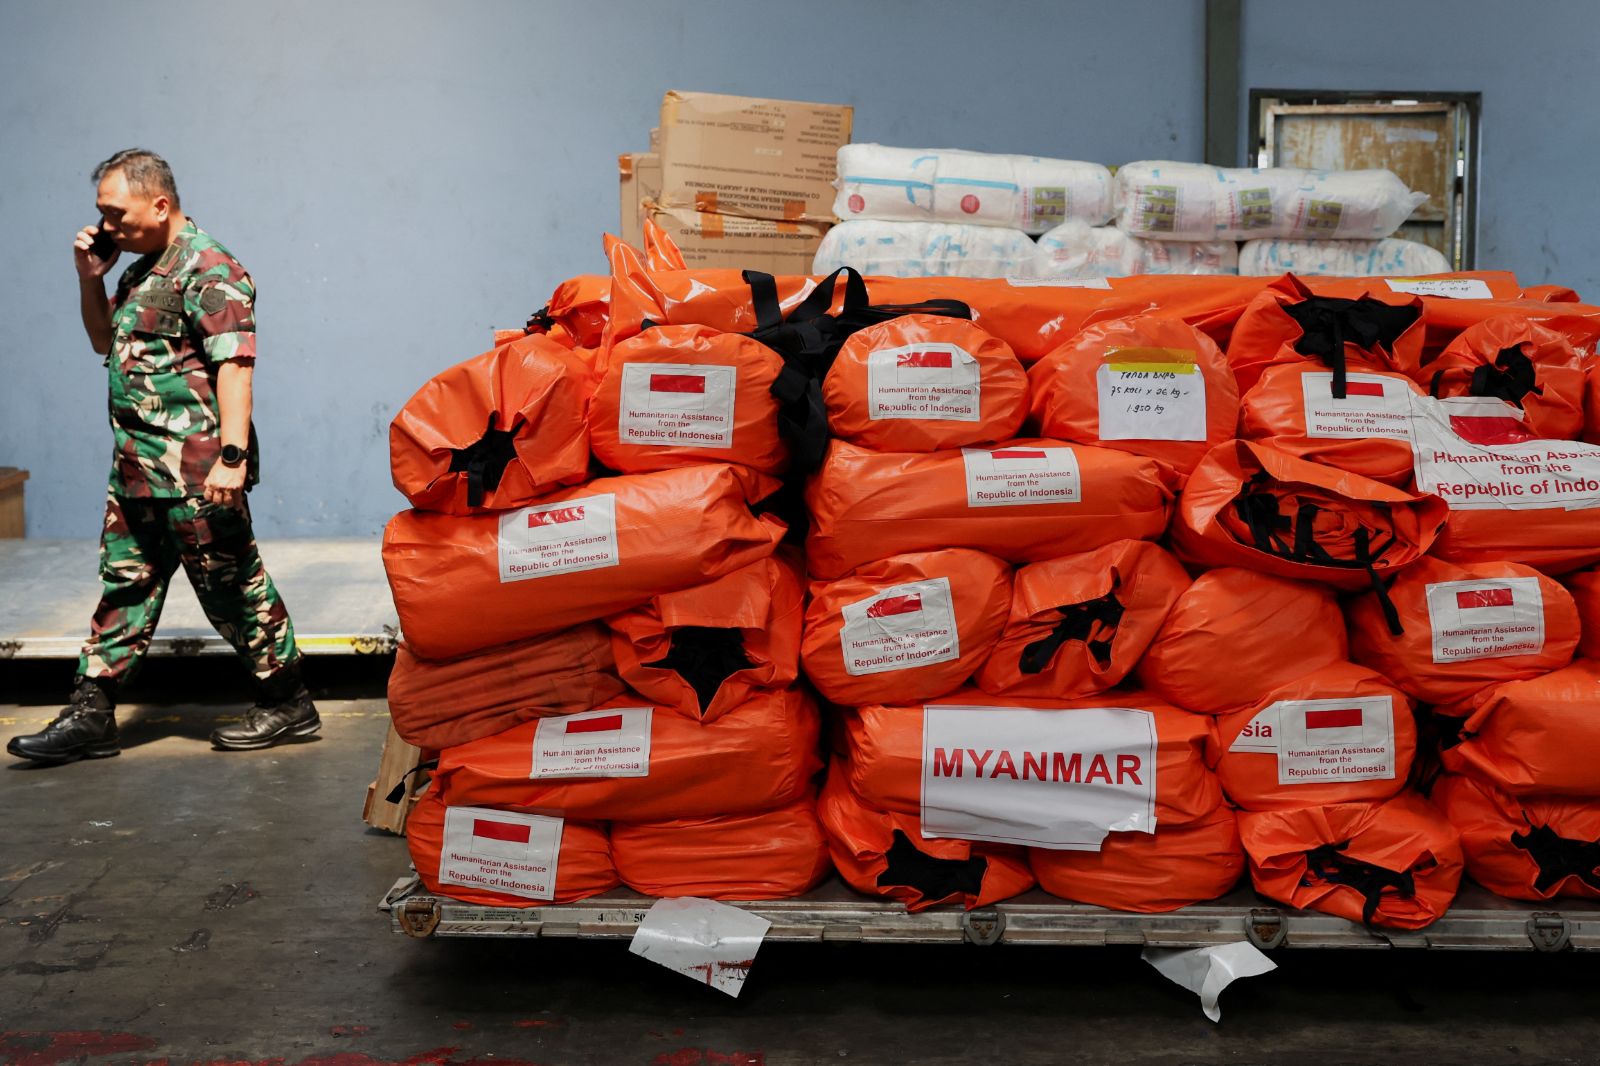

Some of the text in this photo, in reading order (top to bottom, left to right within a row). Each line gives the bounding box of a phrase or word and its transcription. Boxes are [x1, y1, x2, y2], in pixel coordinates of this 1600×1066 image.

[931, 387, 972, 395] Assistance
[878, 404, 916, 412] Republic
[931, 404, 971, 414] Indonesia
[629, 410, 724, 422] Humanitarian Assistance
[1366, 412, 1406, 420] Assistance
[628, 428, 666, 438] Republic
[679, 430, 723, 440] Indonesia
[1501, 464, 1572, 475] from the
[976, 473, 1027, 481] Humanitarian
[977, 491, 1016, 500] Republic
[1030, 488, 1072, 496] Indonesia
[1436, 482, 1524, 498] Republic
[1530, 480, 1548, 494] of
[564, 535, 607, 547] Assistance
[509, 562, 550, 573] Republic
[564, 552, 608, 564] Indonesia
[1442, 625, 1535, 636] Humanitarian Assistance
[1442, 646, 1481, 656] Republic
[1494, 643, 1535, 652] Indonesia
[855, 655, 893, 667] Republic
[896, 653, 904, 661] of
[1288, 746, 1385, 758] Humanitarian Assistance
[933, 747, 1143, 785] MYANMAR
[1289, 768, 1328, 778] Republic
[1343, 764, 1386, 774] Indonesia
[451, 853, 547, 872] Humanitarian Assistance
[480, 866, 498, 875] from
[449, 870, 545, 892] Republic of Indonesia
